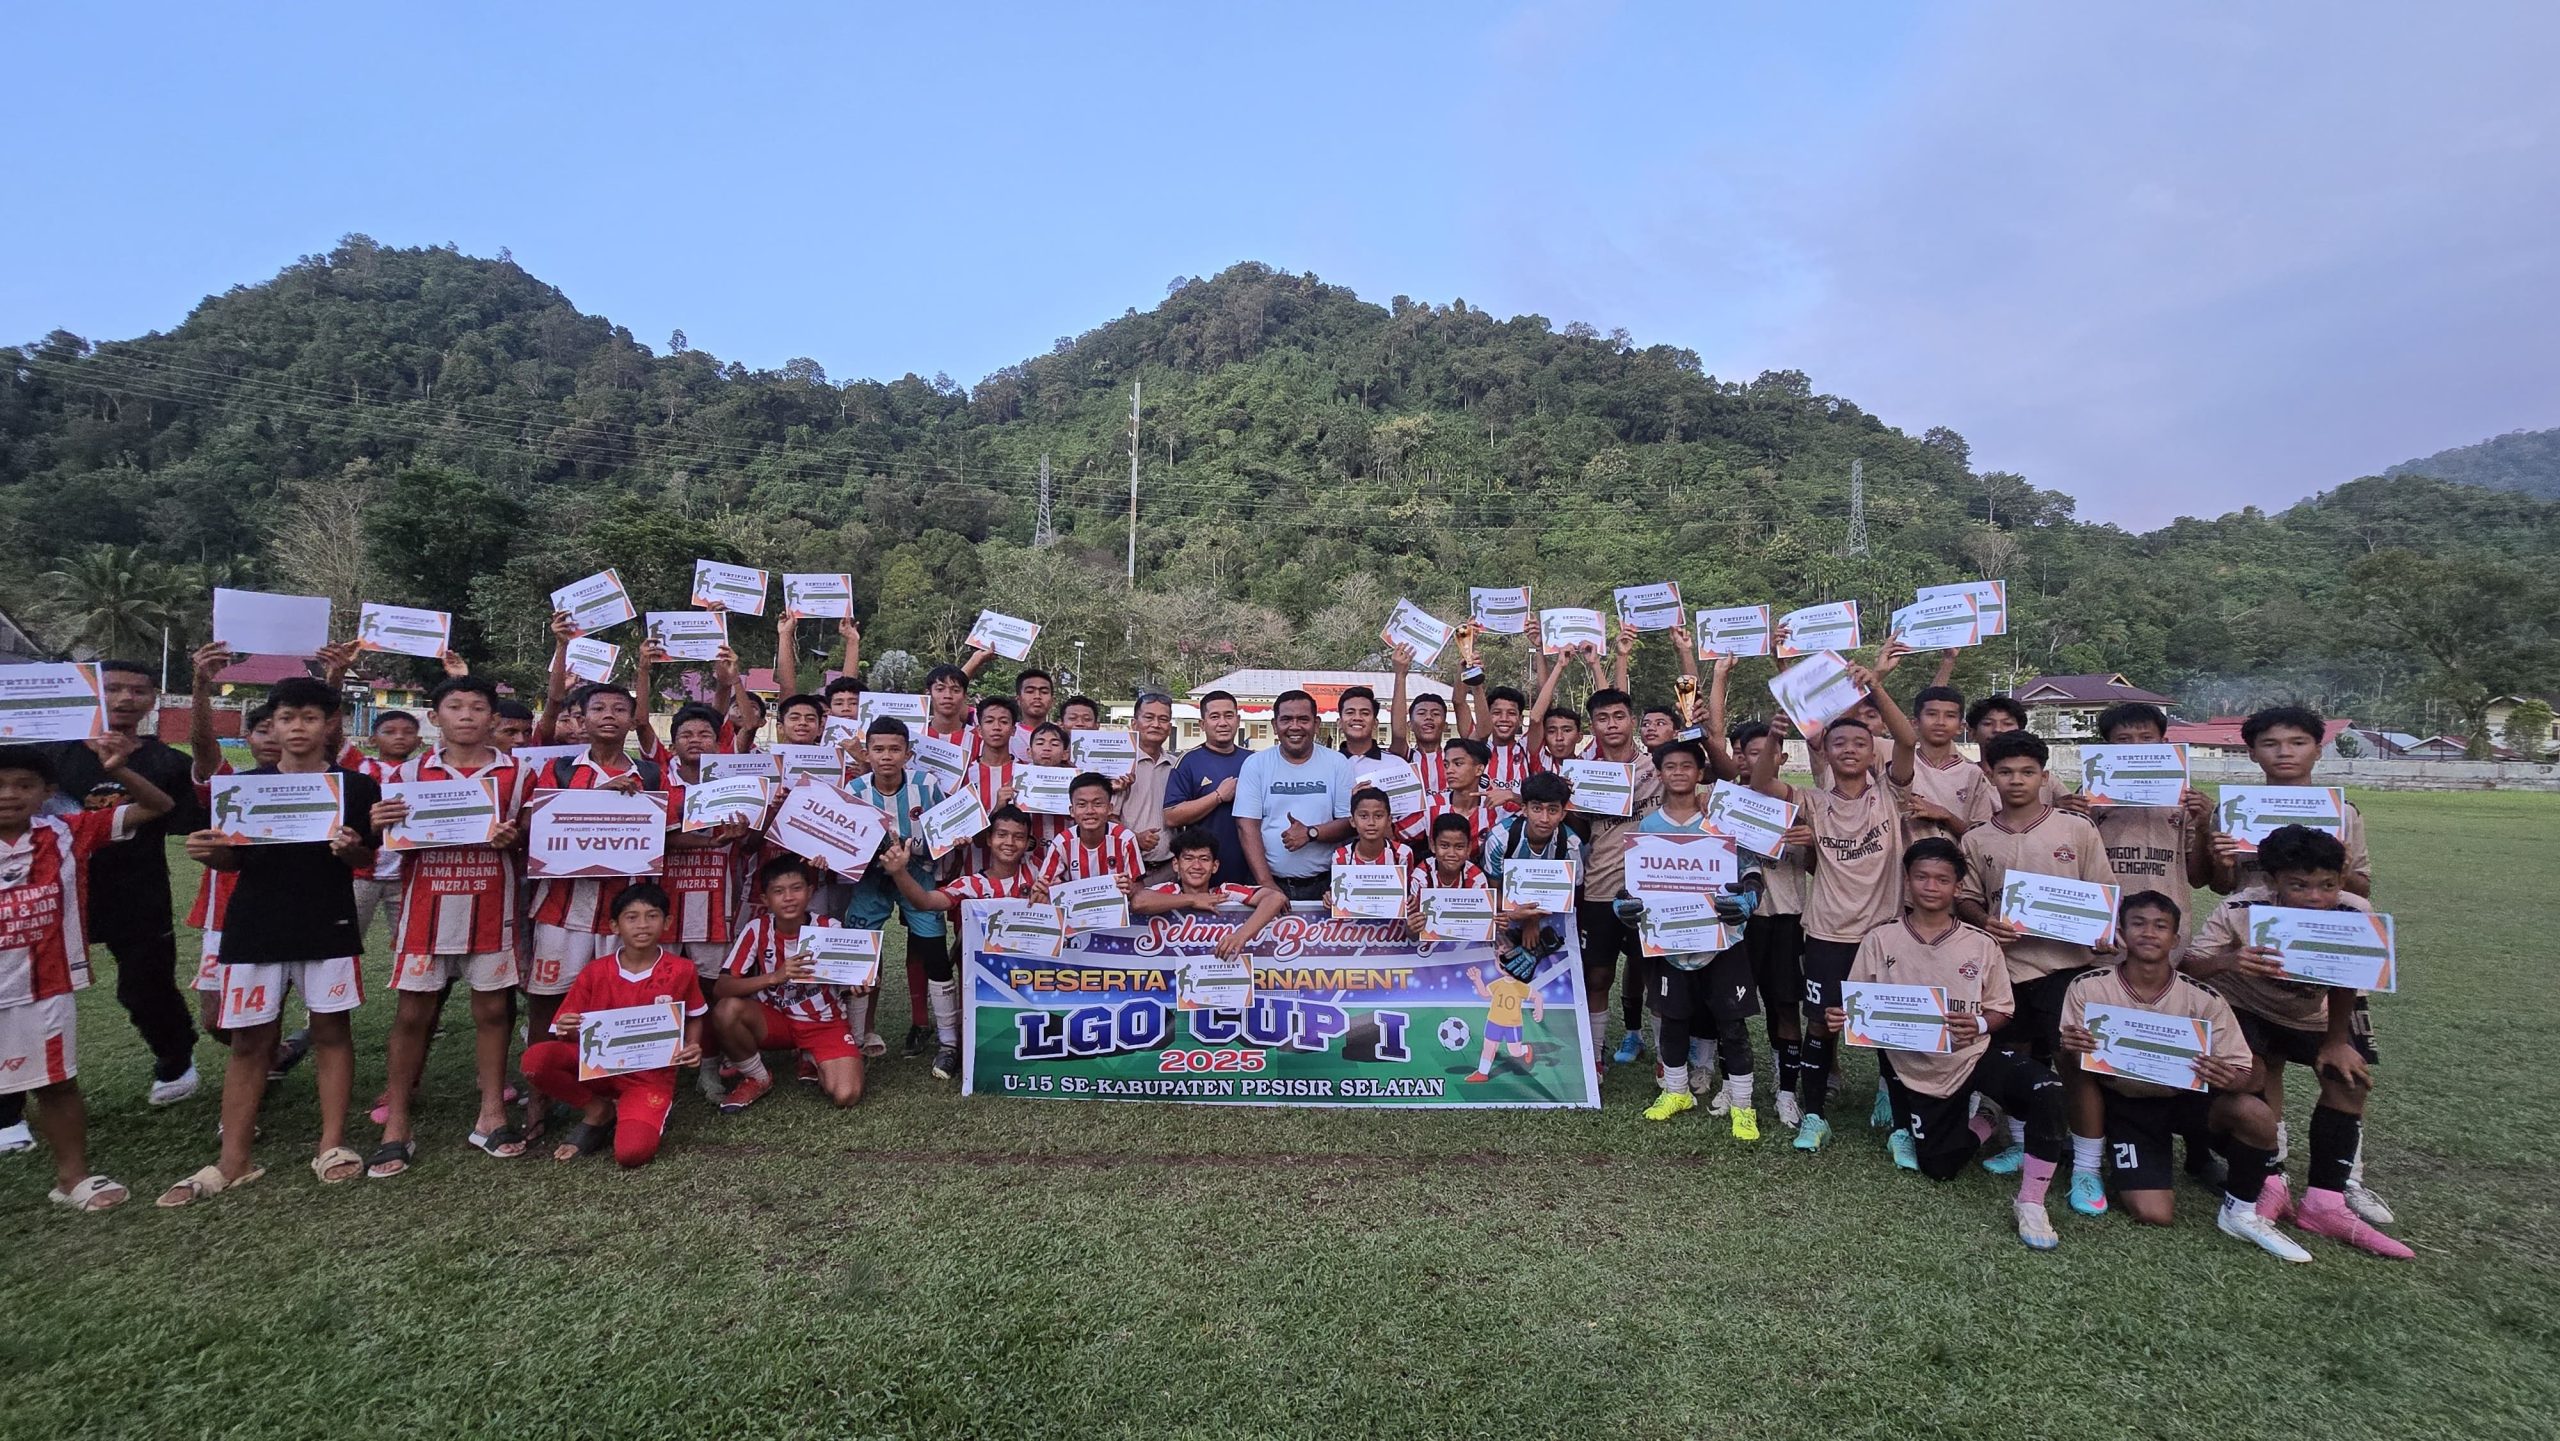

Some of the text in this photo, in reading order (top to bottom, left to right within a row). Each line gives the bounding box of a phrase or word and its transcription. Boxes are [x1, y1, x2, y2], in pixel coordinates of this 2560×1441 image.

[1916, 603, 1964, 615] SERTIFIKAT
[0, 677, 74, 687] ERTIFIKAT
[418, 790, 479, 799] SERTIFIKAT
[1273, 781, 1327, 792] GUESS
[1739, 797, 1781, 815] SERTIFIKAT
[802, 798, 858, 834] JUARA
[860, 826, 869, 837] I
[547, 837, 651, 851] JUARA III
[422, 866, 498, 878] ALMA BUSANA
[1640, 857, 1720, 872] JUARA II
[431, 879, 487, 891] NAZRA 35
[676, 879, 719, 889] NAZRA 35
[2038, 885, 2098, 899] SERTIFIKAT
[1661, 904, 1705, 913] SERTIFIKAT
[825, 937, 869, 945] SERTIFIKAT
[1135, 914, 1267, 957] Selam
[535, 959, 561, 984] 19
[1010, 967, 1413, 992] PESERTA RNAMENT
[1806, 979, 1821, 1004] 55
[1874, 994, 1929, 1003] SERTIFIKAT
[231, 985, 266, 1015] 14
[1498, 992, 1515, 1010] 10
[615, 1014, 668, 1027] SERTIFIKAT
[2124, 1020, 2189, 1037] SERTIFIKAT
[1015, 997, 1411, 1063] LGO CUP I
[1158, 1049, 1267, 1073] 2025
[1003, 1074, 1445, 1097] U-15 SE-KABUPATEN PESISIR SELATAN
[1911, 1113, 1925, 1140] 2
[2113, 1142, 2139, 1169] 21
